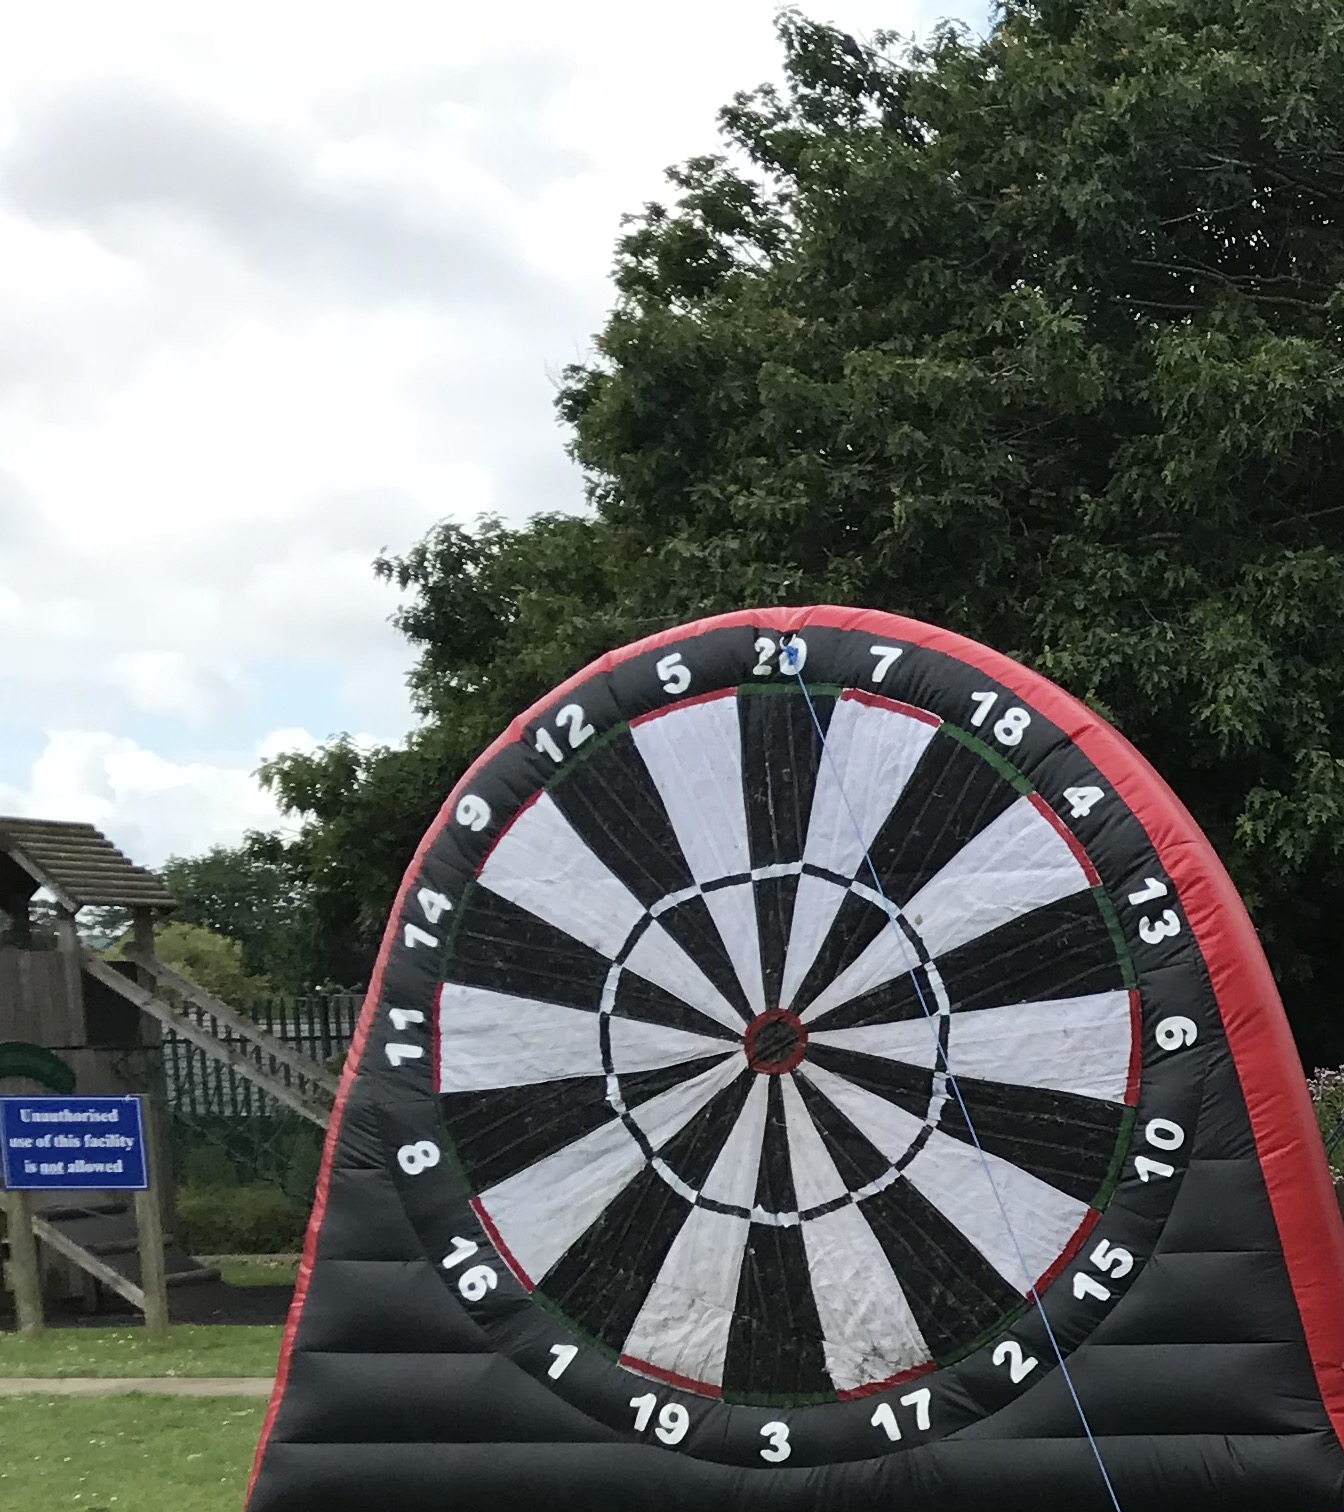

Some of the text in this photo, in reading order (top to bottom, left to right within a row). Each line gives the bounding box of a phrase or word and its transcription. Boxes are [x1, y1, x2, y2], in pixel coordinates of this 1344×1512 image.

[656, 653, 692, 694] 5
[753, 636, 807, 676] 20
[870, 645, 904, 682] 7
[534, 703, 595, 763] 12
[970, 690, 1031, 746] 18
[456, 794, 492, 832] 9
[1063, 785, 1105, 818] 4
[404, 886, 452, 949] 14
[1127, 877, 1181, 945] 13
[384, 1007, 425, 1067] 11
[20, 1108, 120, 1123] Unauthorised
[9, 1134, 135, 1151] use of this facility
[398, 1140, 441, 1176] 8
[1134, 1118, 1185, 1183] 10
[24, 1159, 124, 1175] is not allowed
[443, 1236, 499, 1302] 16
[1072, 1238, 1134, 1302] 15
[547, 1343, 579, 1380] 1
[992, 1340, 1039, 1384] 2
[629, 1392, 690, 1445] 19
[870, 1387, 931, 1442] 17
[759, 1421, 792, 1463] 3
